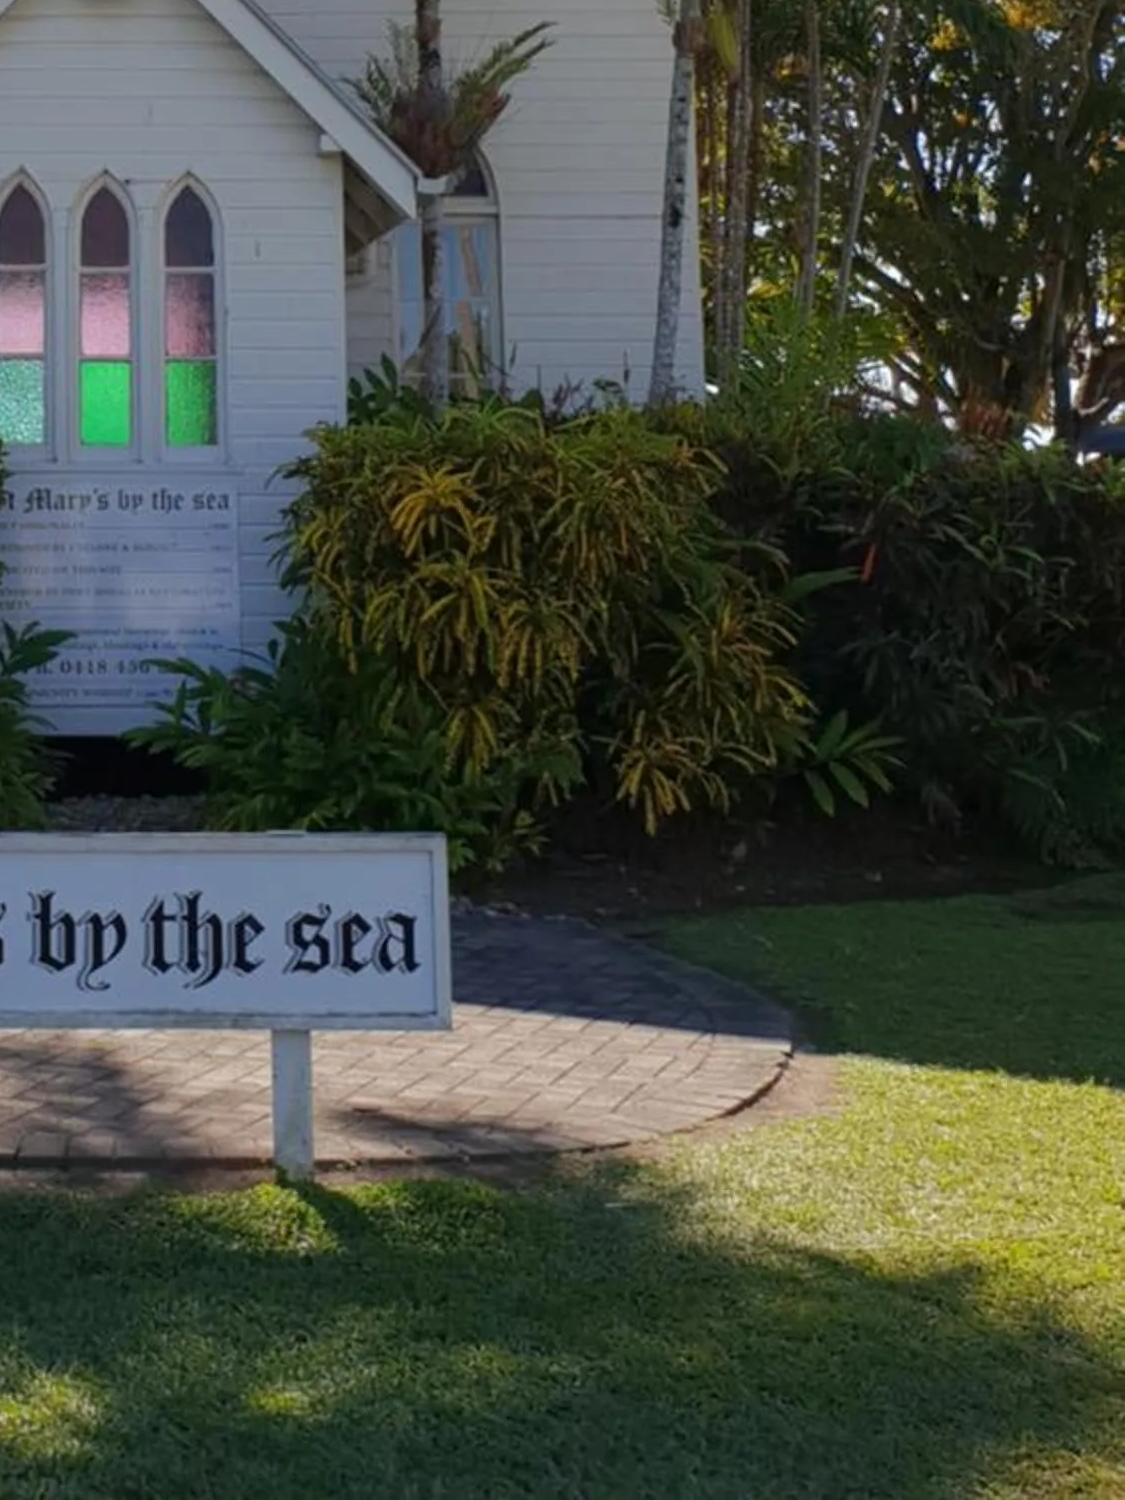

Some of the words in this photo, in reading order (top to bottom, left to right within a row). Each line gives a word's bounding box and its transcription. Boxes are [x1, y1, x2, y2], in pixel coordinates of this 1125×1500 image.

[24, 487, 109, 514] Mary's
[117, 489, 144, 514] by
[152, 488, 184, 513] the
[192, 489, 230, 511] sea
[28, 890, 127, 991] by
[141, 891, 266, 990] the
[283, 902, 421, 975] sea
